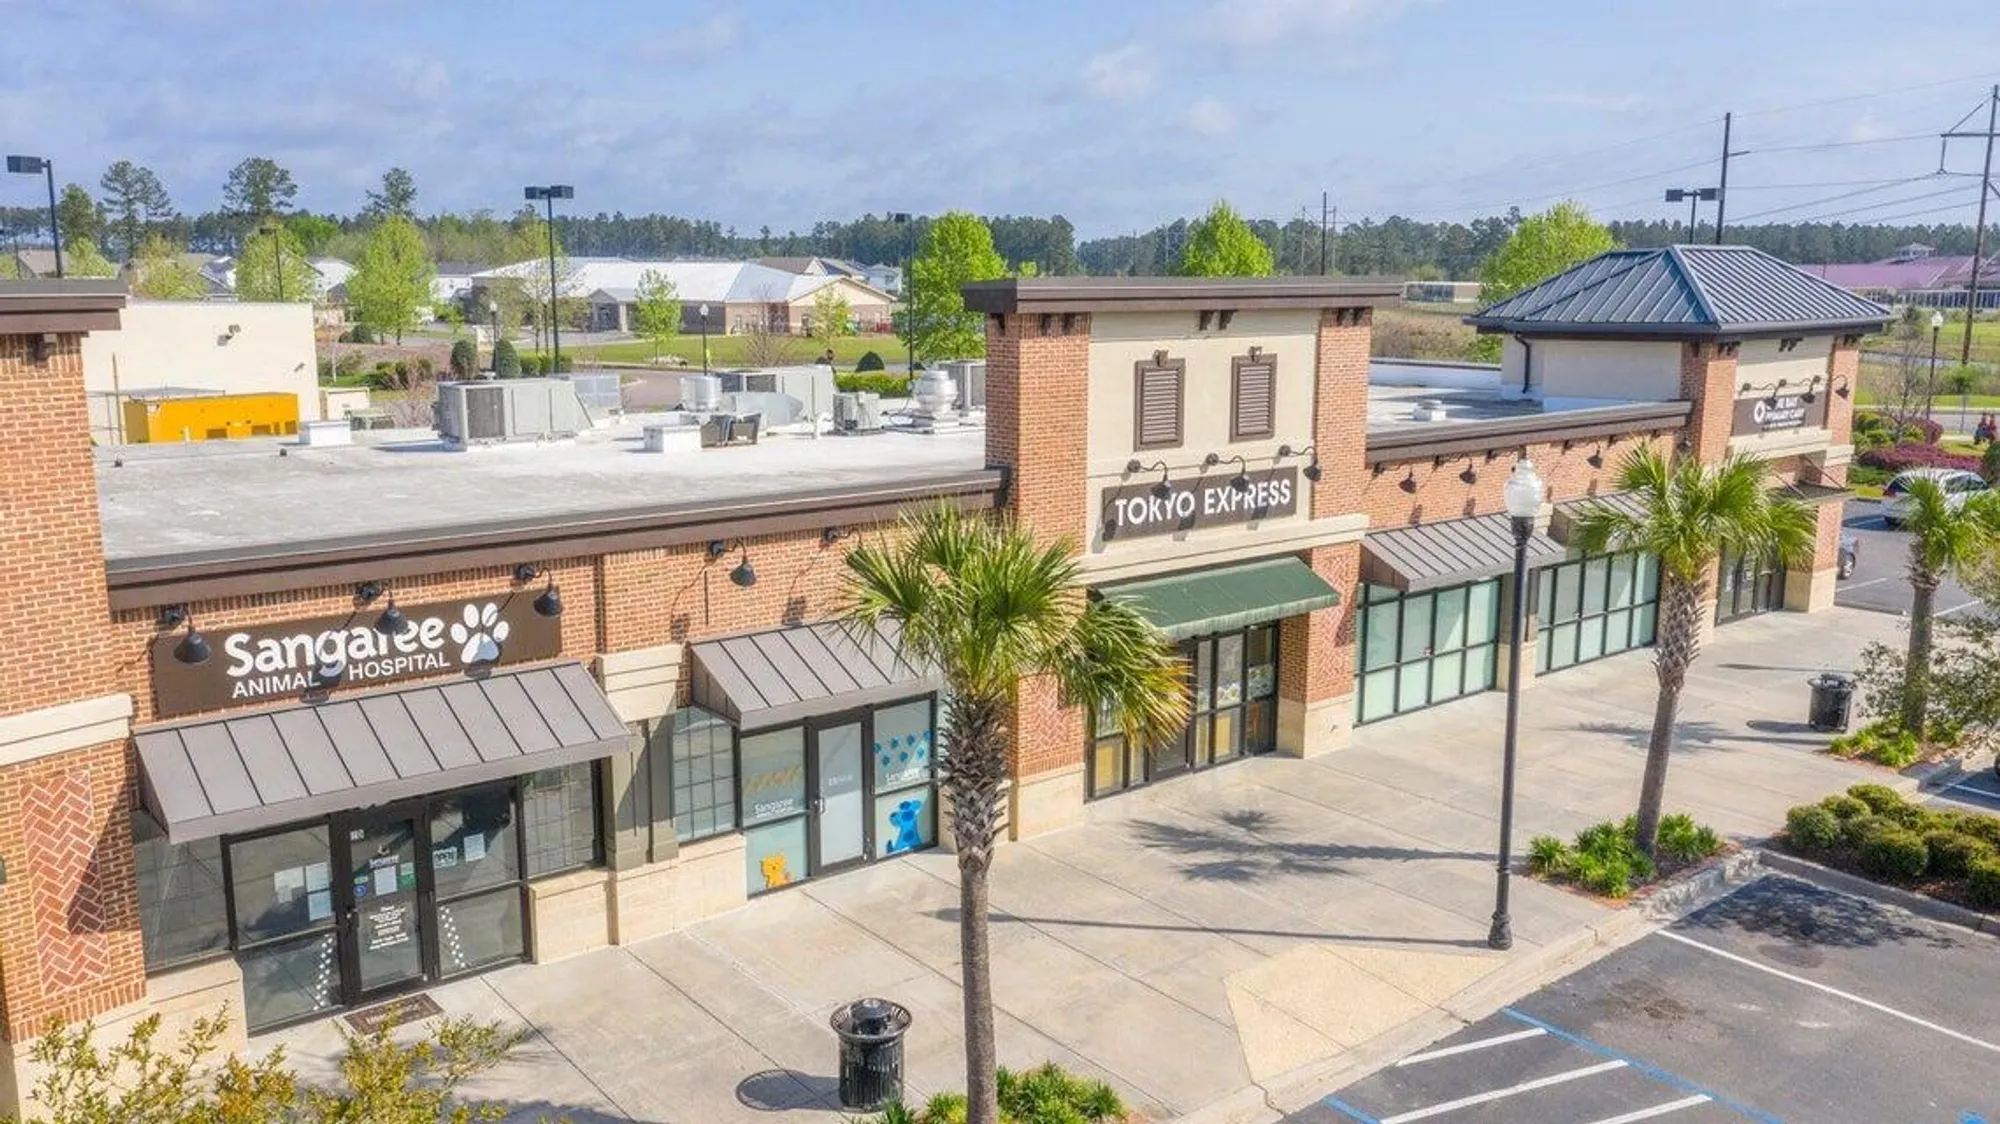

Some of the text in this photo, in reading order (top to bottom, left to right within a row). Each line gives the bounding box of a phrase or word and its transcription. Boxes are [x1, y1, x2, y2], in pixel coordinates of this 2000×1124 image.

[1115, 478, 1291, 526] TOKYO EXPRESS
[224, 616, 445, 677] Sangaree
[232, 652, 450, 699] ANIMAL HOSPITAL
